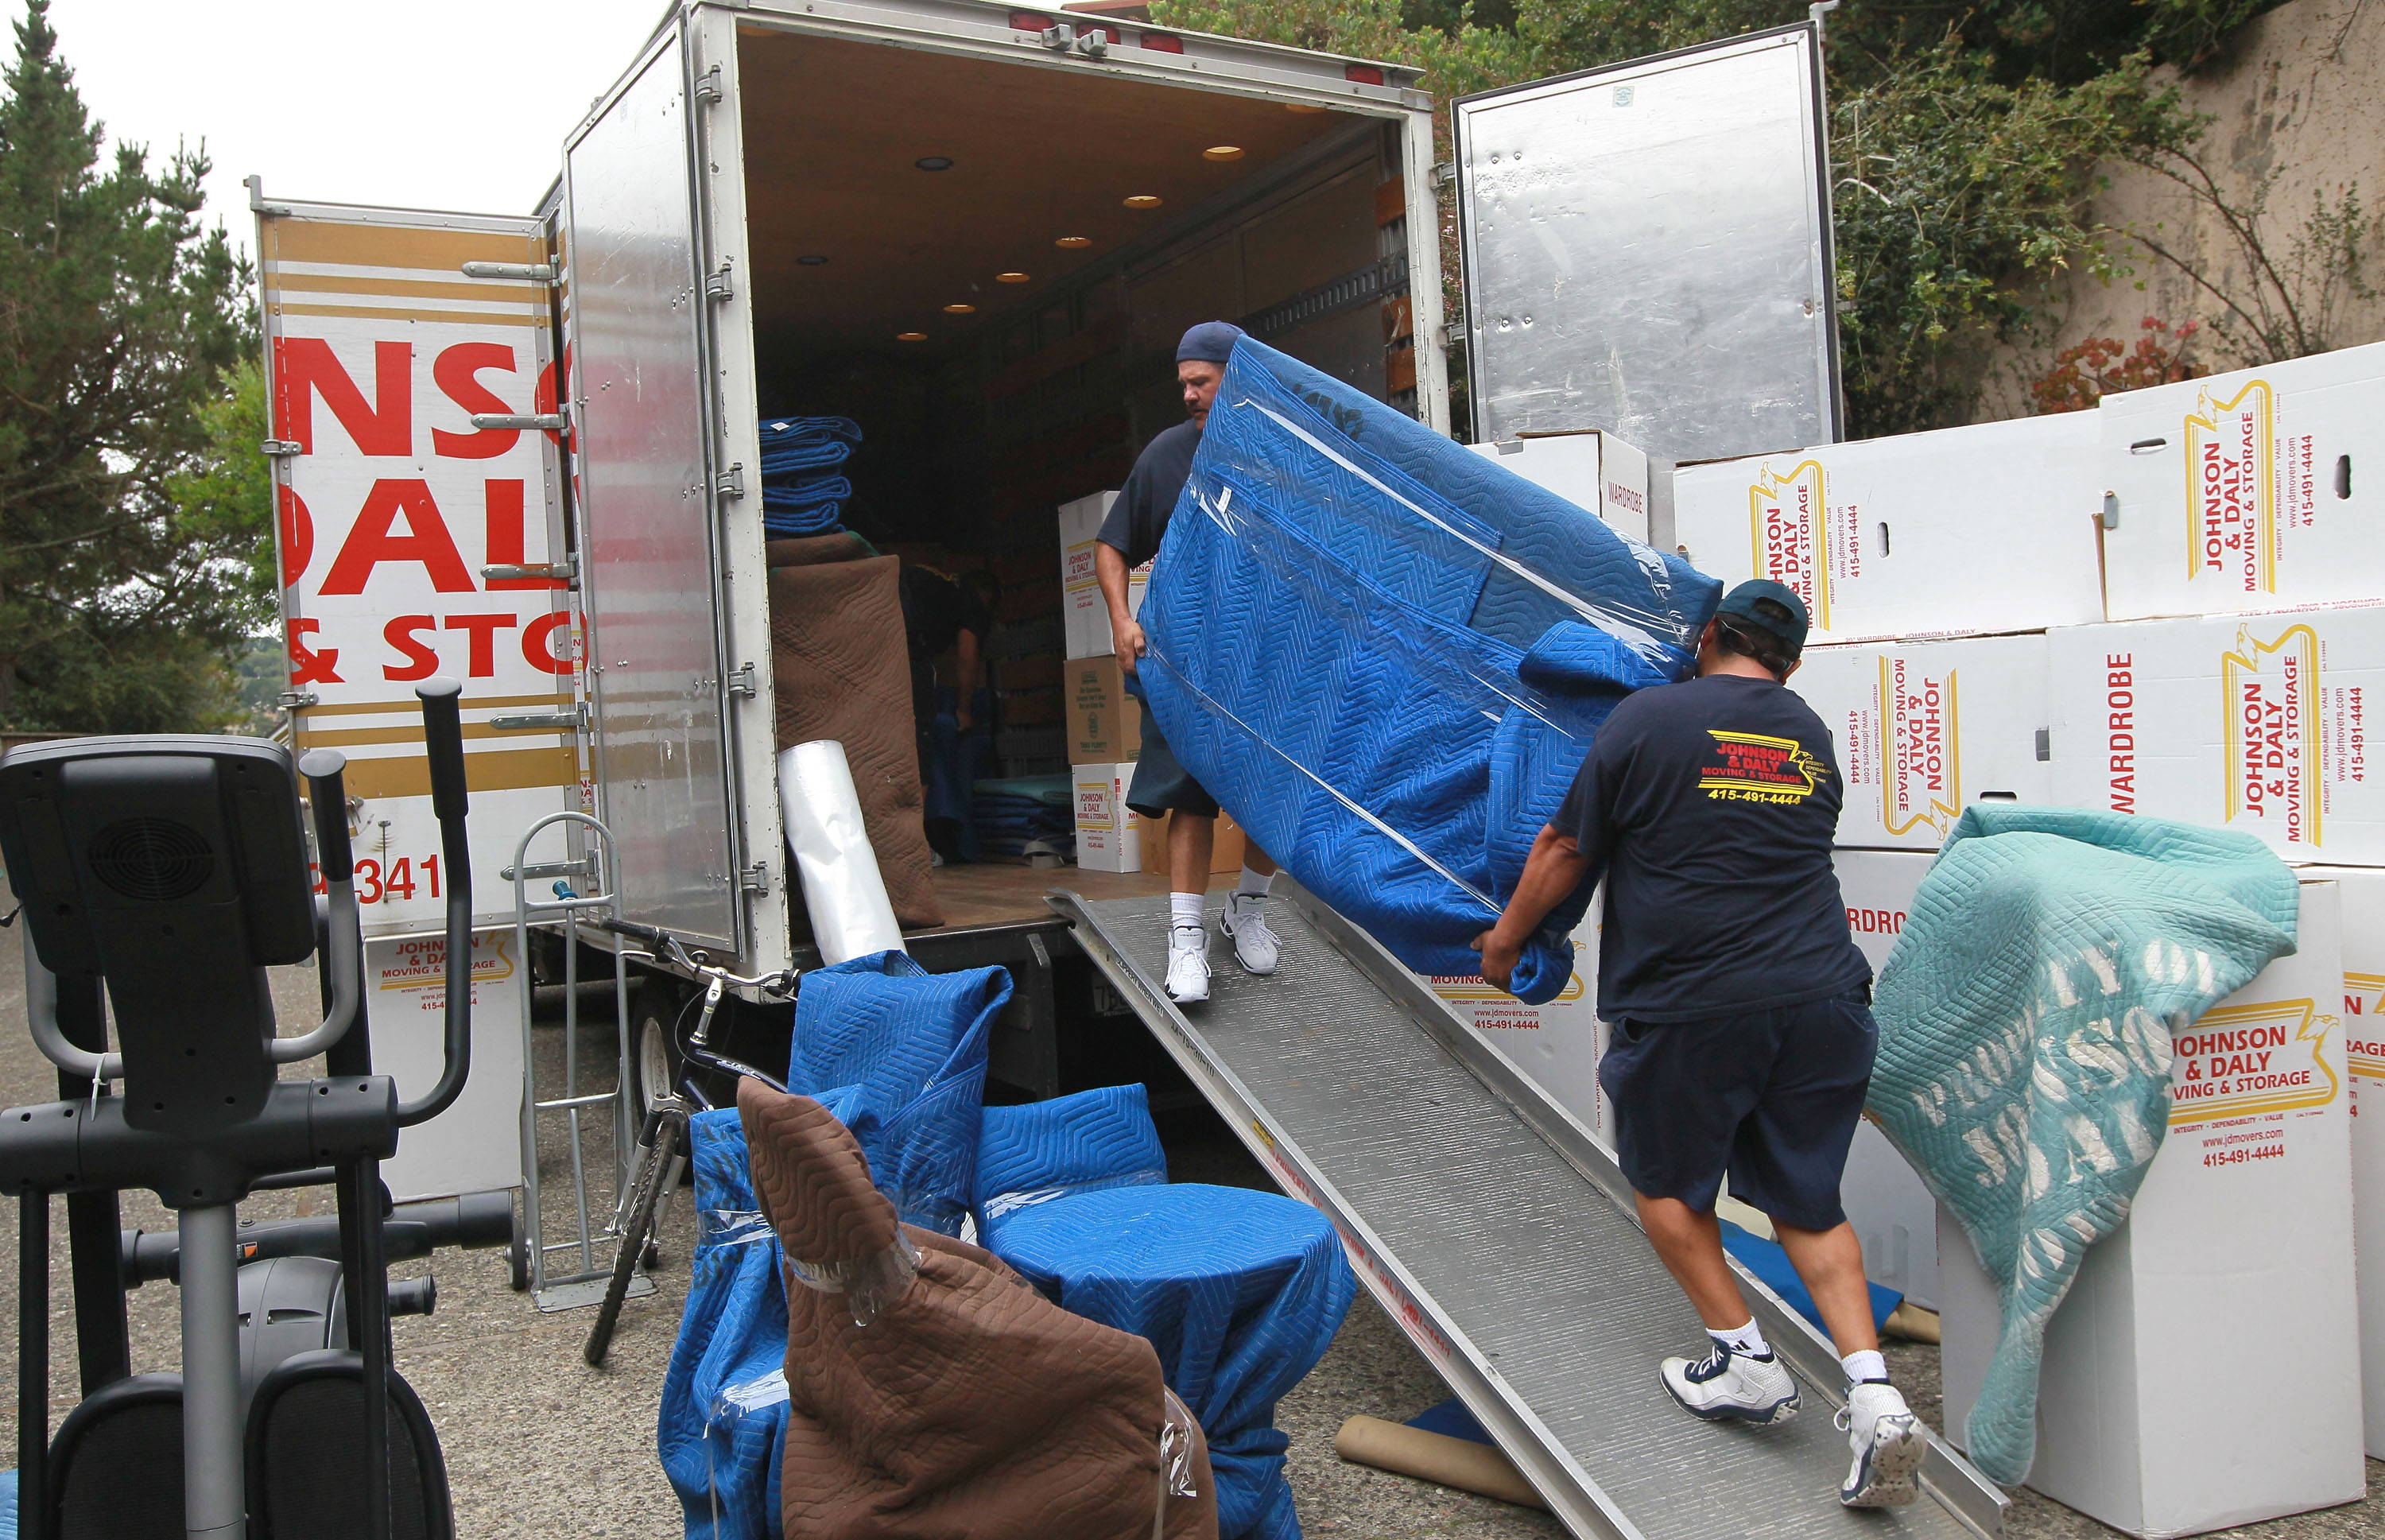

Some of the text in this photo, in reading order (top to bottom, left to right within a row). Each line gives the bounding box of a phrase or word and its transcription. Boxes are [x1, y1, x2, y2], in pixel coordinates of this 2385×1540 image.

[1607, 481, 1642, 514] WARDROBE
[2205, 443, 2222, 571] JOHNSON
[2224, 458, 2240, 550] & DALY
[2242, 412, 2256, 592] MOVING & STORAGE
[2287, 437, 2298, 528] www.jdmovers.com
[2302, 435, 2314, 526] 415-491-4444
[1767, 508, 1783, 584] HNSON
[1784, 521, 1799, 572] DALY
[1798, 485, 1810, 550] STORAGE
[1837, 506, 1847, 579] www.jdmovers.com
[1848, 505, 1860, 578] 415-491-4444
[1068, 551, 1091, 565] JOHNSON
[1077, 562, 1088, 572] DALY
[1801, 556, 1811, 564] &
[1716, 743, 1788, 762] JOHNSON
[1849, 710, 1860, 784] 415-491-4444
[1861, 710, 1870, 784] www.jdmovers.com
[1894, 660, 1909, 811] MOVING & STORAGE
[1908, 695, 1925, 776] & DALY
[1924, 677, 1942, 790] JOHNSON
[2107, 653, 2135, 814] WARDROBE
[2244, 684, 2263, 817] JOHNSON
[2265, 700, 2284, 797] & DALY
[2285, 656, 2300, 842] MOVING & STORAGE
[2336, 688, 2347, 782] www.jdmovers.com
[2350, 687, 2364, 782] 415-491-4444
[1701, 767, 1746, 778] MOVING
[1759, 773, 1801, 783] STORAGE
[1728, 756, 1780, 773] & DALY
[1708, 789, 1801, 805] 415-491-4444
[396, 937, 479, 955] JOHNN
[1846, 907, 1906, 934] RDRO
[382, 967, 429, 978] MOVING
[409, 955, 420, 966] &
[1431, 976, 1484, 984] MOVING
[1475, 1020, 1539, 1030] 415-491-4444
[2174, 1070, 2310, 1100] VING & STORAGE
[2185, 1051, 2272, 1080] & DALY
[2174, 1113, 2283, 1134] INTEGRITY DEPENDABILITY VALUE
[2202, 1129, 2283, 1147] www.jdmovers.com
[2204, 1144, 2284, 1167] 415-491-4444
